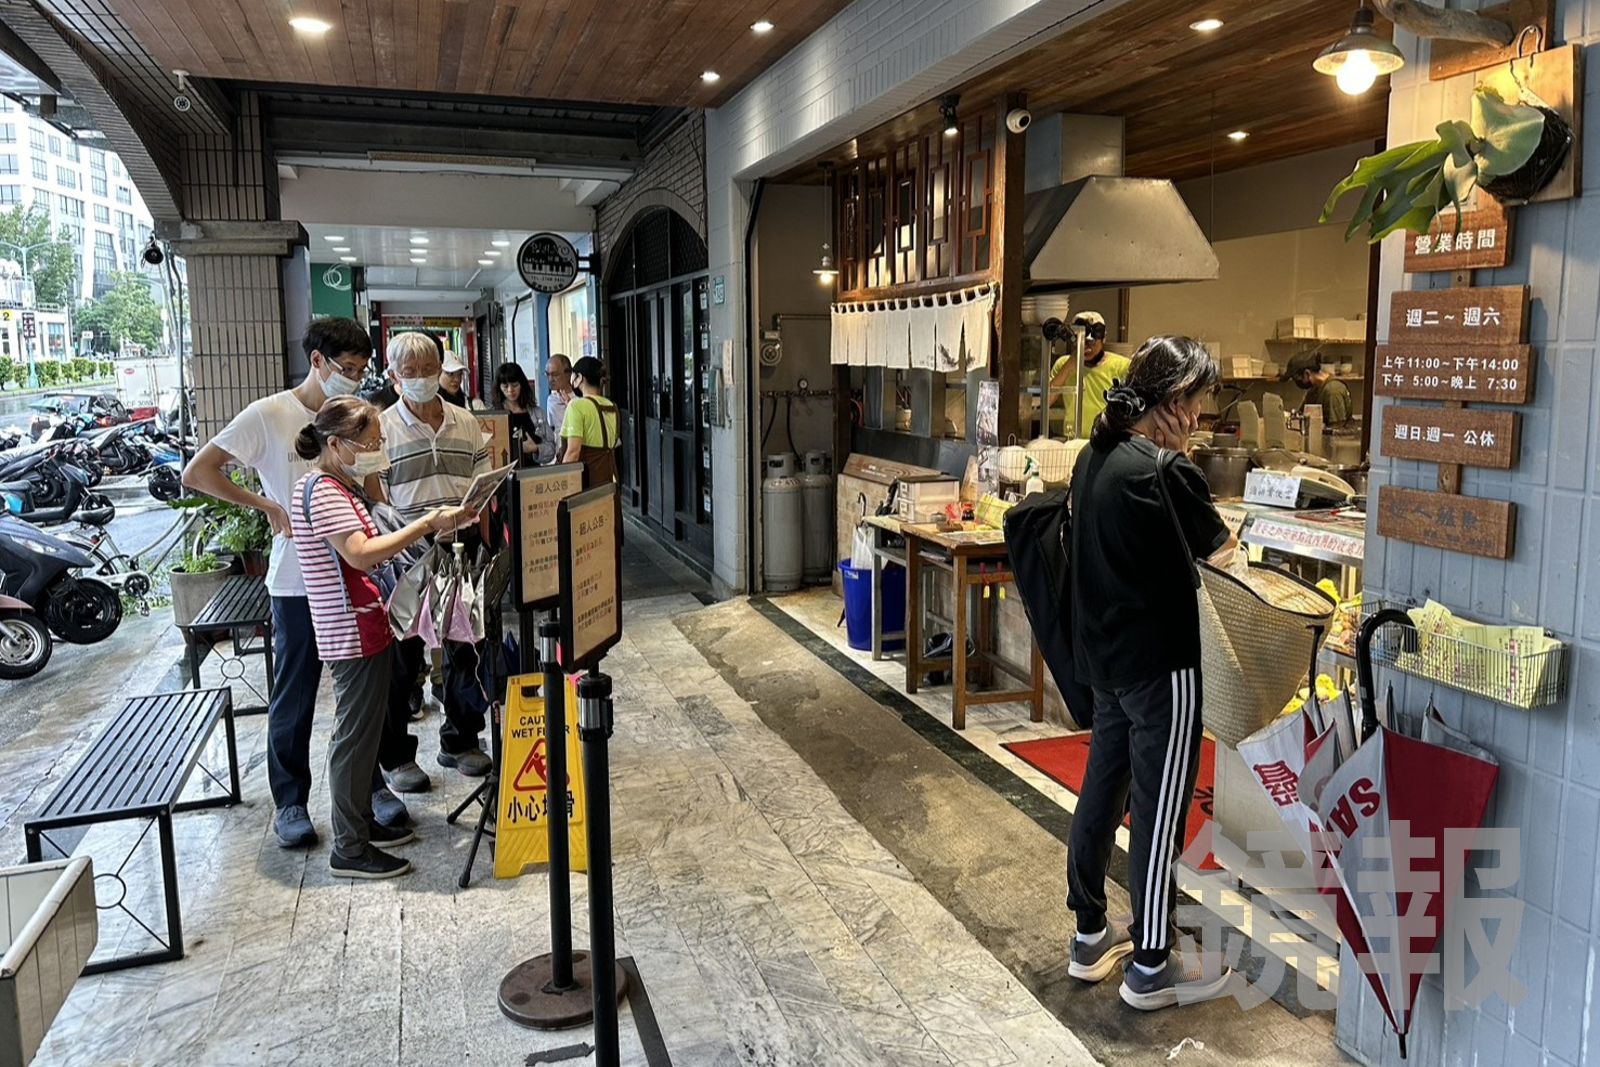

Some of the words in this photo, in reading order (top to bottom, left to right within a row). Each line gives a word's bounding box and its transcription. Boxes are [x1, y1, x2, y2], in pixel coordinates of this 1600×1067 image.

[1415, 228, 1496, 255] 營業時間
[520, 714, 548, 726] CAUT
[511, 728, 534, 739] WET
